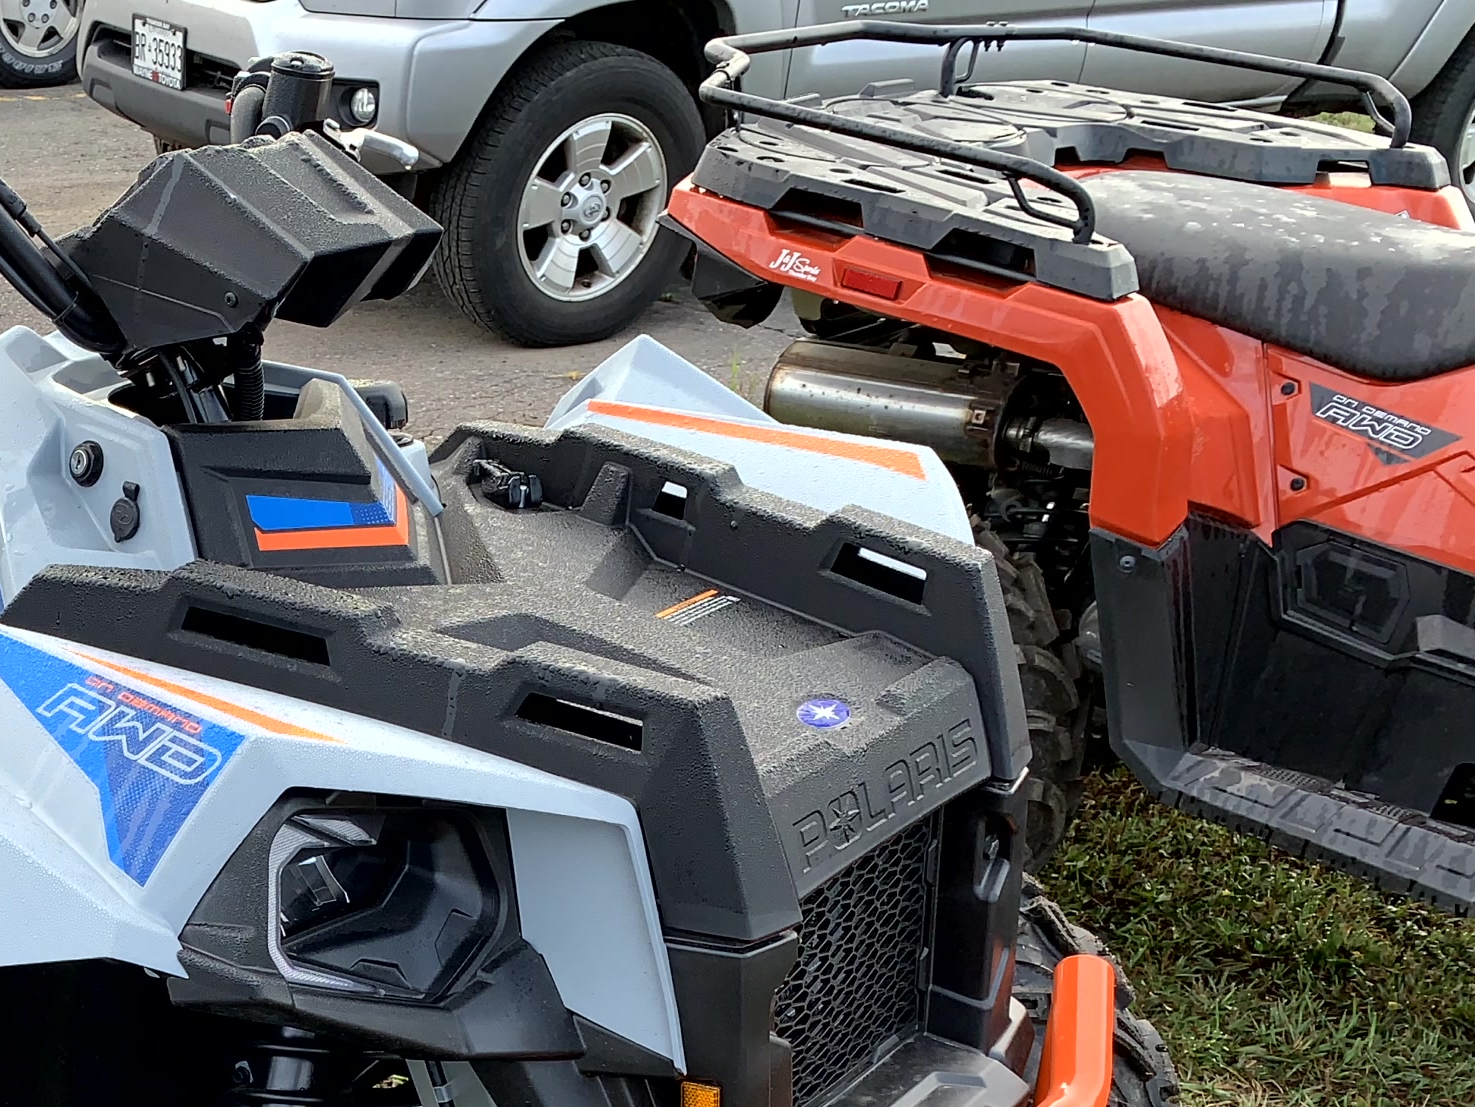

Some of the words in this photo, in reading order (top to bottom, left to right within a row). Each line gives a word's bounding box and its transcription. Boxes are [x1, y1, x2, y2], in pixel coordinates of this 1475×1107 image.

[841, 0, 929, 17] TACOMA
[135, 31, 146, 62] BR
[152, 37, 183, 72] 35933
[158, 72, 181, 89] TOYOTA
[1316, 402, 1423, 449] AWD
[35, 683, 222, 785] AWD
[792, 718, 978, 874] POLARIS
